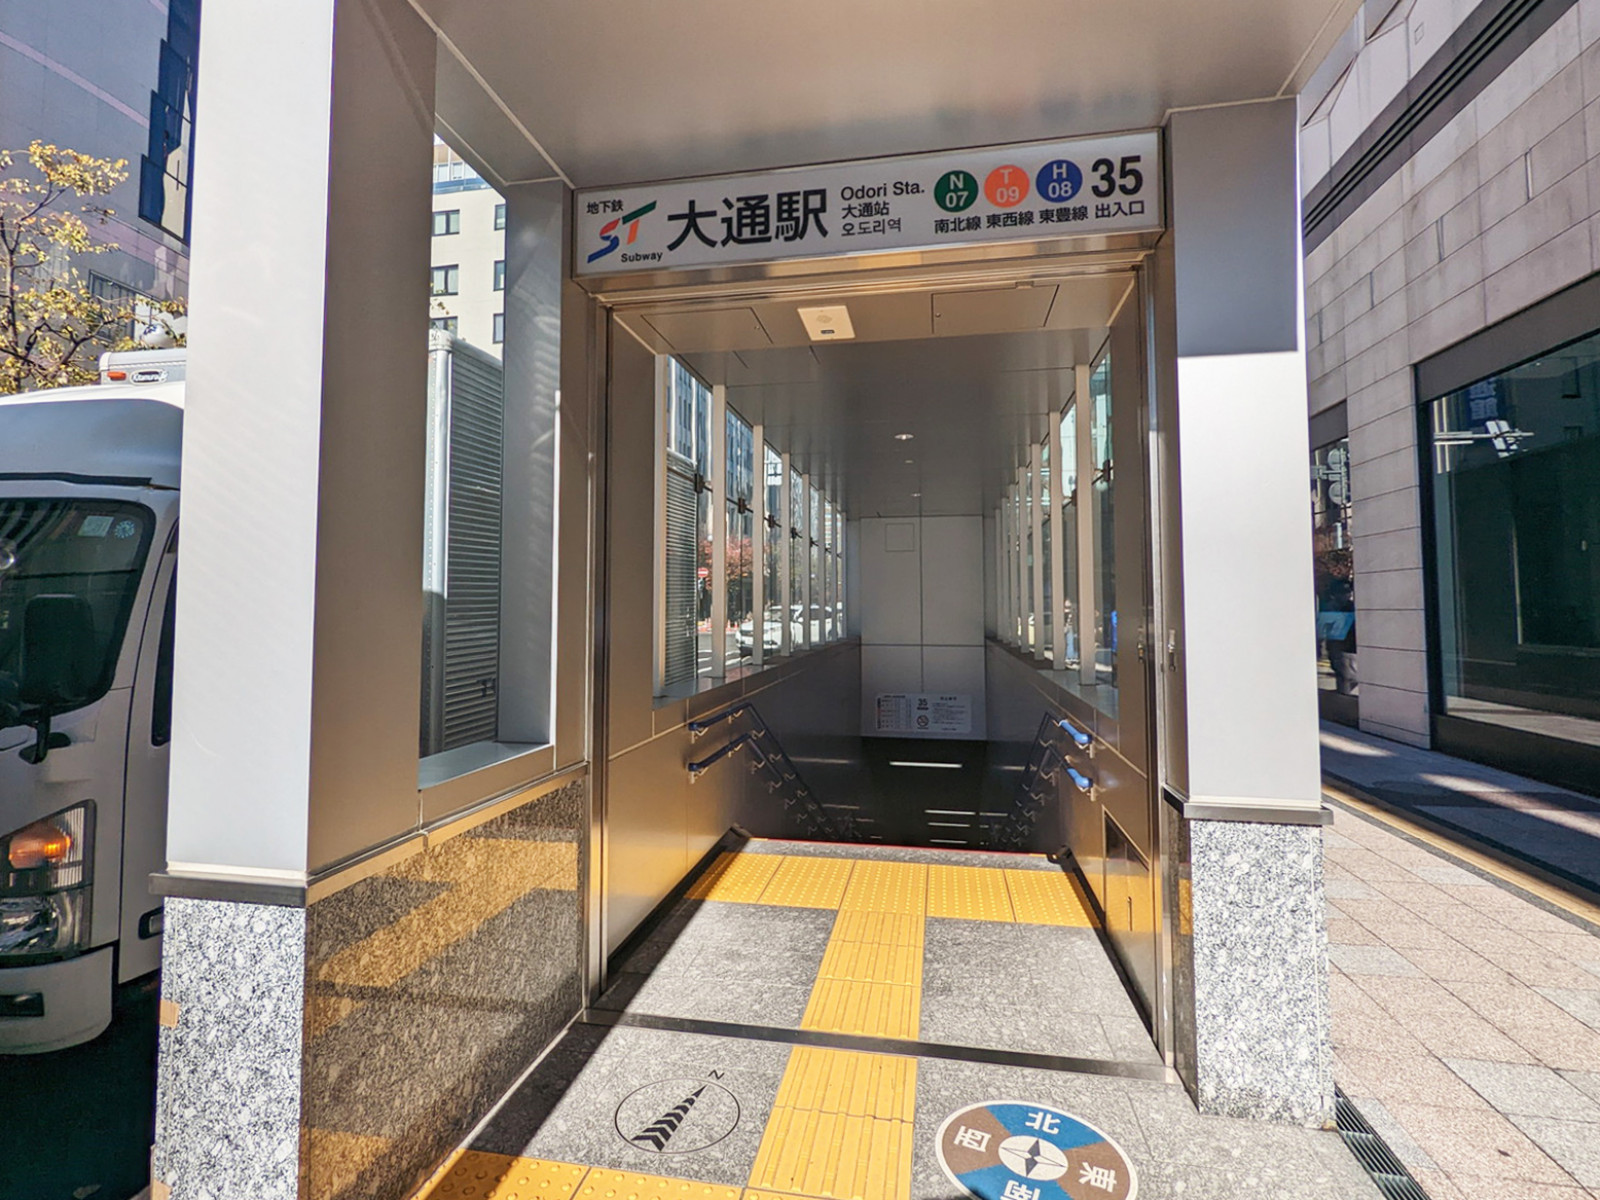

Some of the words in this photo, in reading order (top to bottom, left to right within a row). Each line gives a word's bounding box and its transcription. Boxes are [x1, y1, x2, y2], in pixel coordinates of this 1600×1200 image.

[1000, 168, 1013, 184] T
[1053, 163, 1067, 179] H
[1091, 155, 1143, 198] 35
[841, 182, 887, 201] Odori
[893, 180, 925, 196] Sta.
[950, 174, 964, 190] N
[1048, 181, 1072, 198] 08
[945, 191, 969, 208] 07
[996, 186, 1019, 203] 09
[586, 199, 624, 215] 地下鉄
[841, 200, 890, 219] 大通站
[1094, 200, 1145, 219] 出入口
[667, 188, 829, 251] 大通駅
[841, 217, 902, 237] 오도리역
[934, 215, 981, 234] 南北線
[986, 210, 1035, 228] 東西線
[1039, 205, 1089, 224] 東豊線
[621, 251, 663, 264] Subway
[708, 1069, 725, 1080] N
[1025, 1111, 1061, 1135] 北
[953, 1125, 991, 1153] 西
[1079, 1161, 1118, 1193] 東
